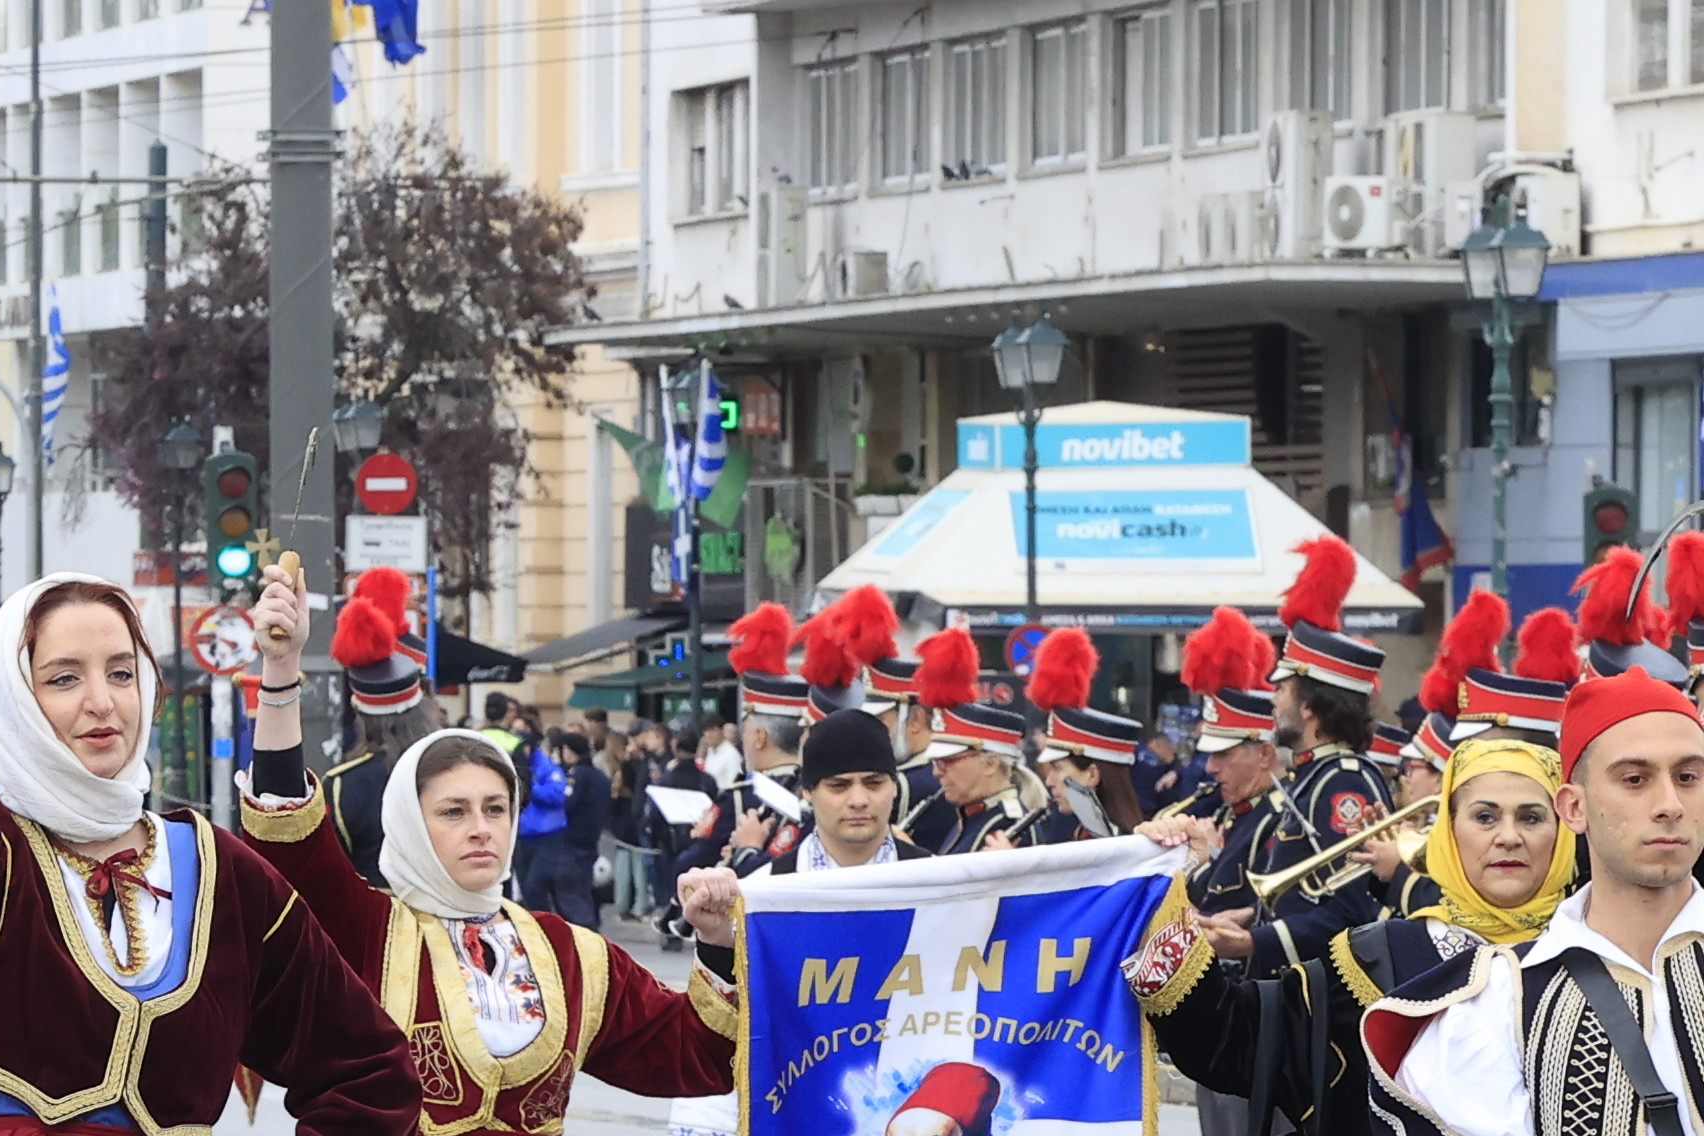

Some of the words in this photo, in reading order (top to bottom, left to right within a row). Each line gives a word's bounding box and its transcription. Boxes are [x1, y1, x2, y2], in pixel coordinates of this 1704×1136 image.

[1060, 429, 1186, 462] novibet
[1056, 518, 1187, 540] novicash
[797, 936, 1093, 1008] ΜΑΝΗ
[764, 1018, 892, 1115] ΣΥΛΛΟΓΟΣ
[898, 1011, 1126, 1074] ΑΡΕΟΠΟΛΙΤΩΝ
